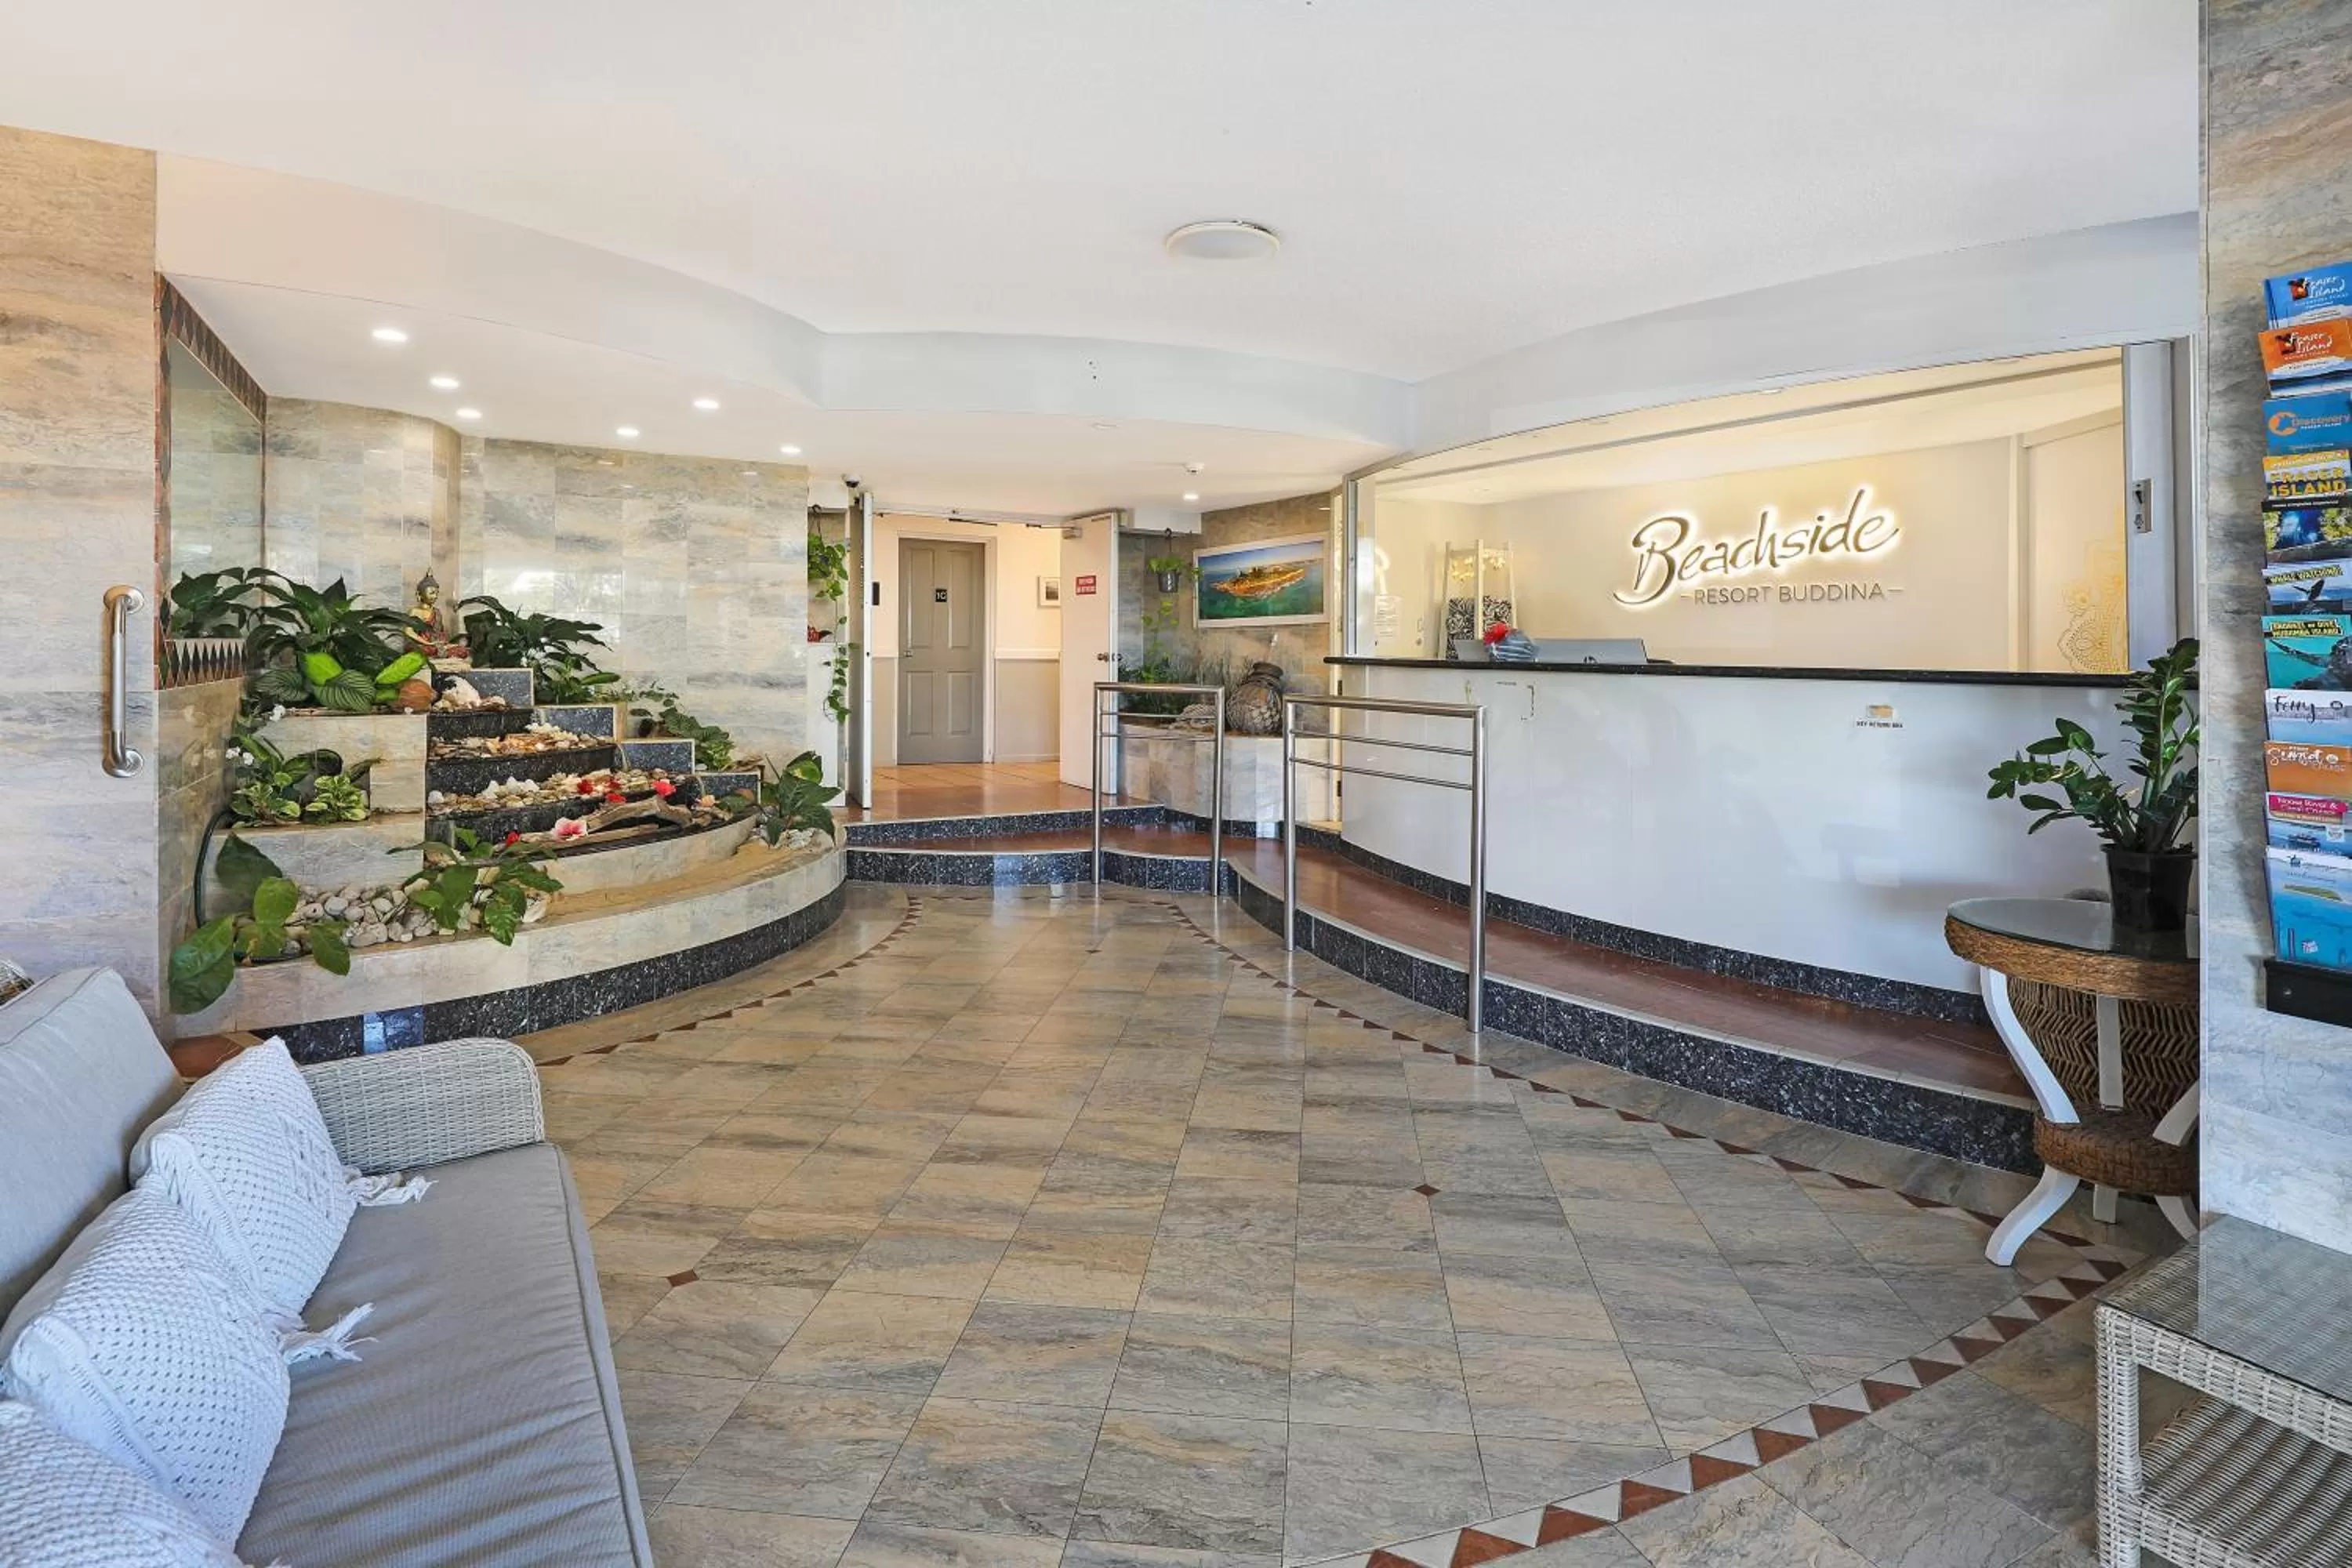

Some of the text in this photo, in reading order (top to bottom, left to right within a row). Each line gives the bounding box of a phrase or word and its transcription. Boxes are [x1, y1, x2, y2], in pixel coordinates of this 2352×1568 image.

[2303, 276, 2339, 289] Fraser
[2308, 279, 2346, 299] Island
[2289, 332, 2325, 346] Fraser
[2296, 336, 2333, 354] Island
[2292, 413, 2350, 427] Discovery
[2270, 466, 2344, 484] FRASER
[2270, 480, 2347, 497] ISLAND
[1613, 488, 1900, 604] Beachside
[1694, 583, 1883, 605] RESORT BUDDINA
[2267, 747, 2324, 766] Sunset
